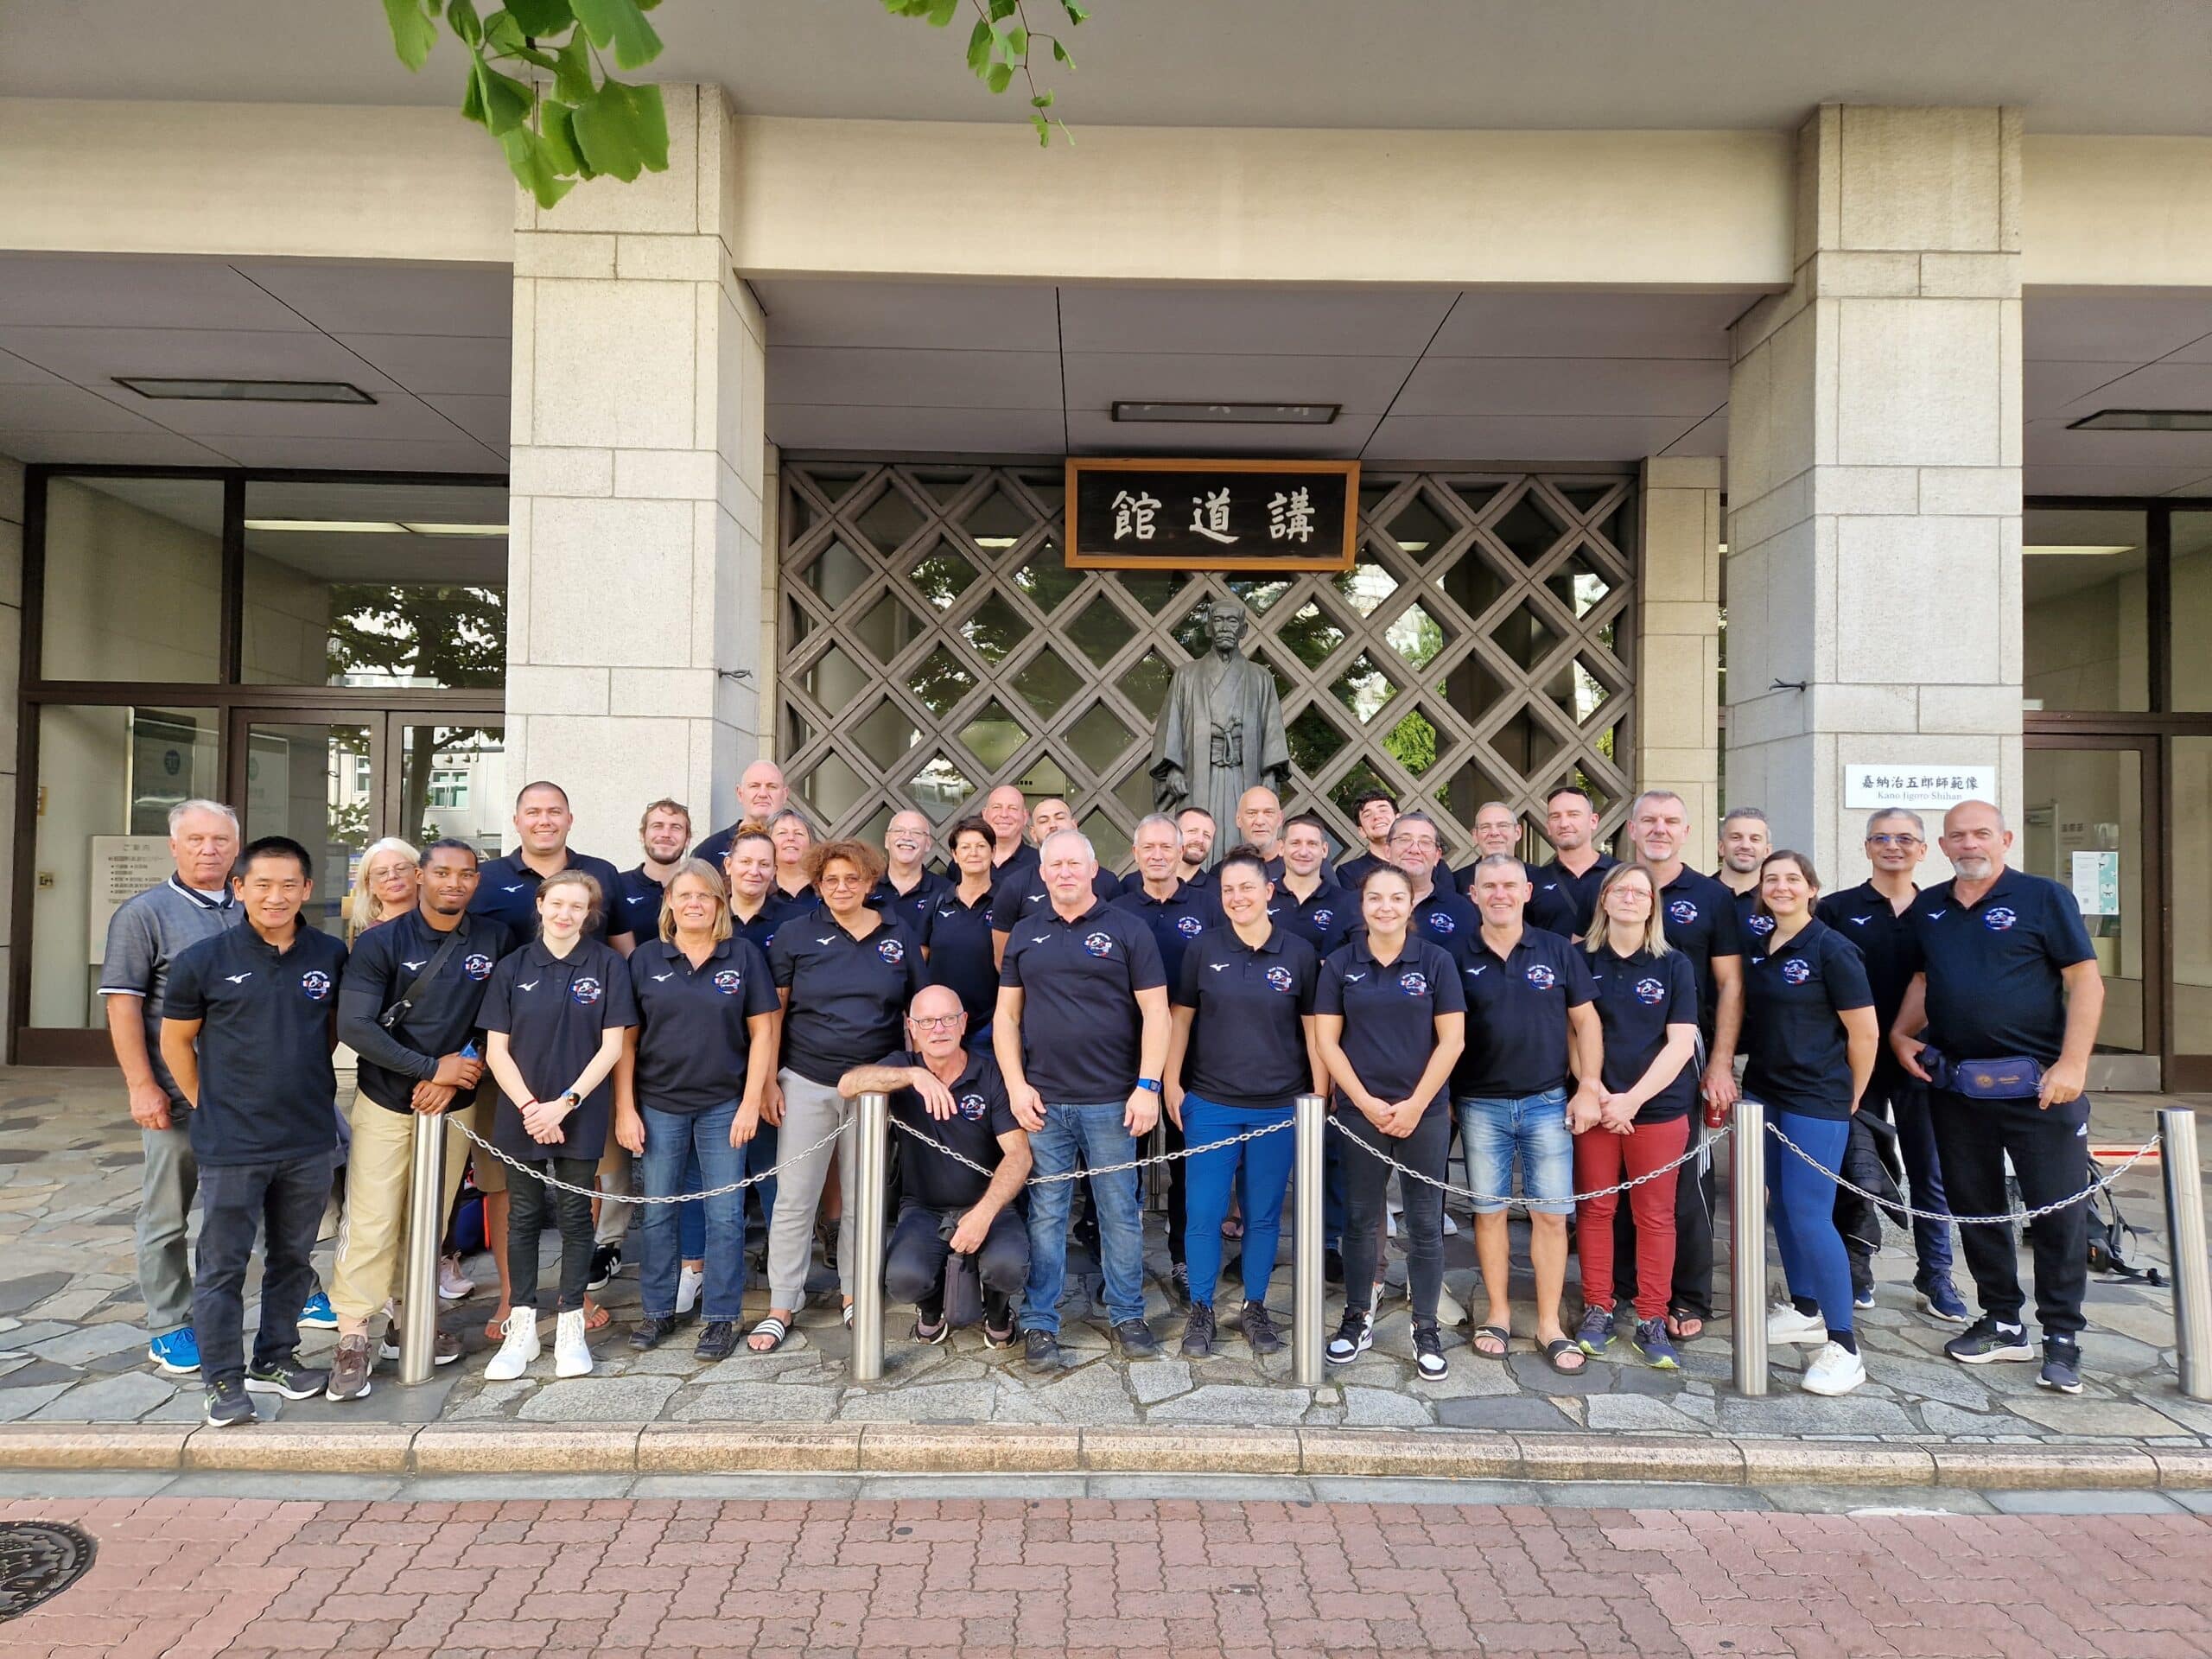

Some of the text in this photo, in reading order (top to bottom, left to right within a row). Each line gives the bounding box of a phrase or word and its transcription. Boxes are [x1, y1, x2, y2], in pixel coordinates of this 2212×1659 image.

[1862, 774, 1979, 790] 嘉納治五郎師範像
[1878, 791, 1962, 802] Kano Jigoro Shihan
